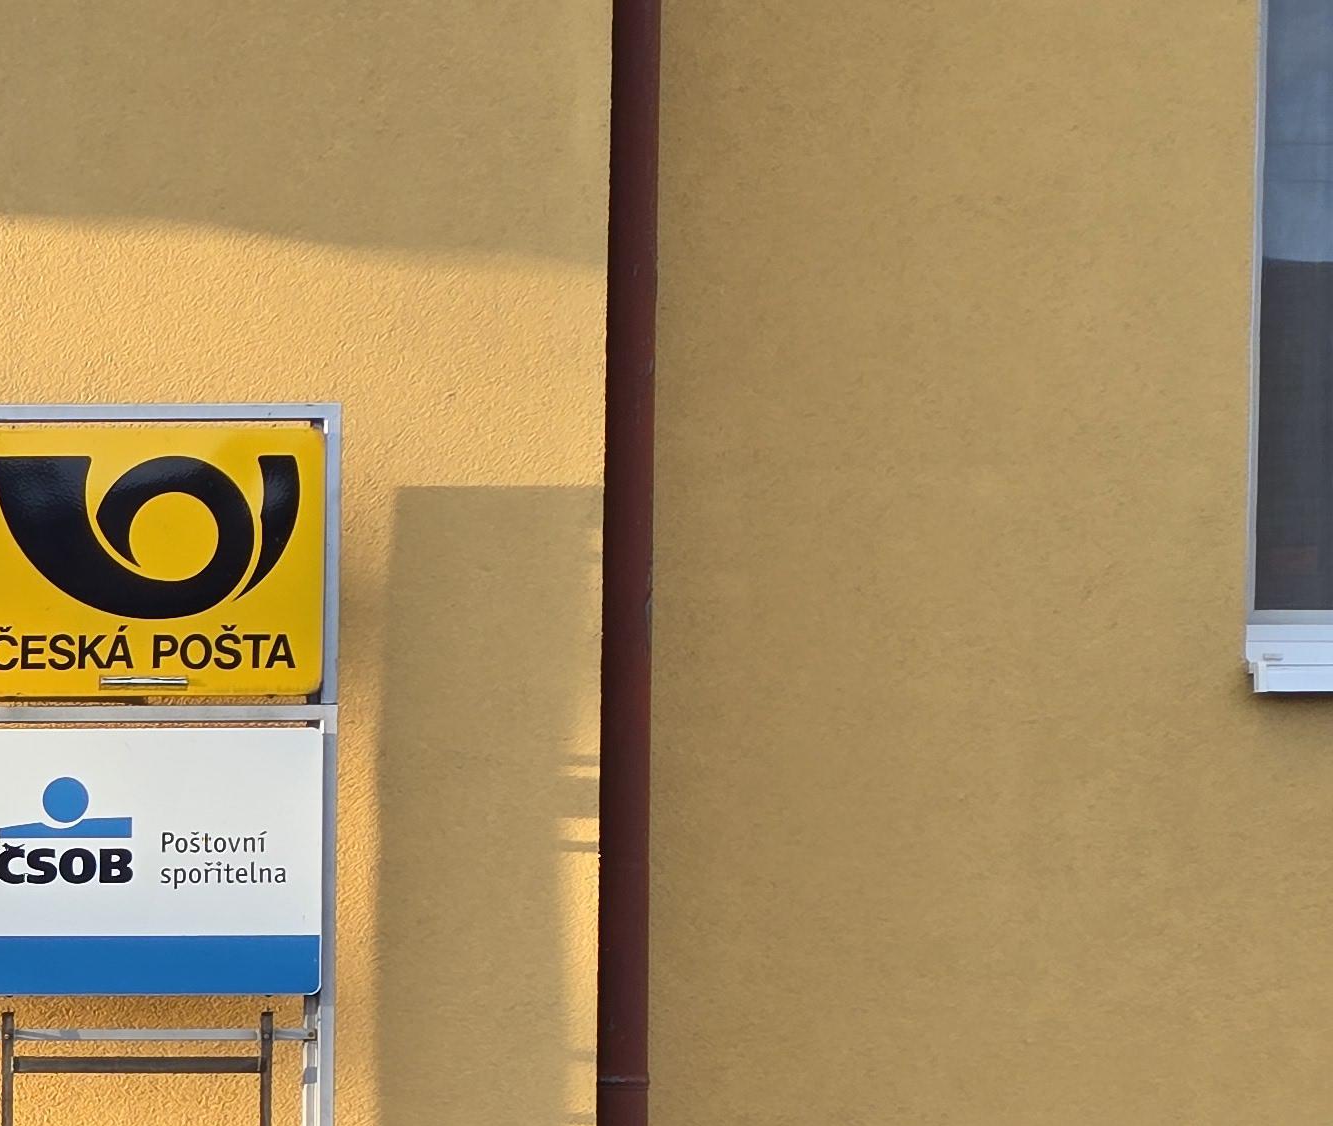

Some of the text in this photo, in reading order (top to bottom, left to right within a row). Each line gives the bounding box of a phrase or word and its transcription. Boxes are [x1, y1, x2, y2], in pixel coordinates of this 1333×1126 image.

[153, 624, 297, 670] POŠTA
[161, 830, 268, 855] Poštovní
[160, 860, 287, 889] spořitelna
